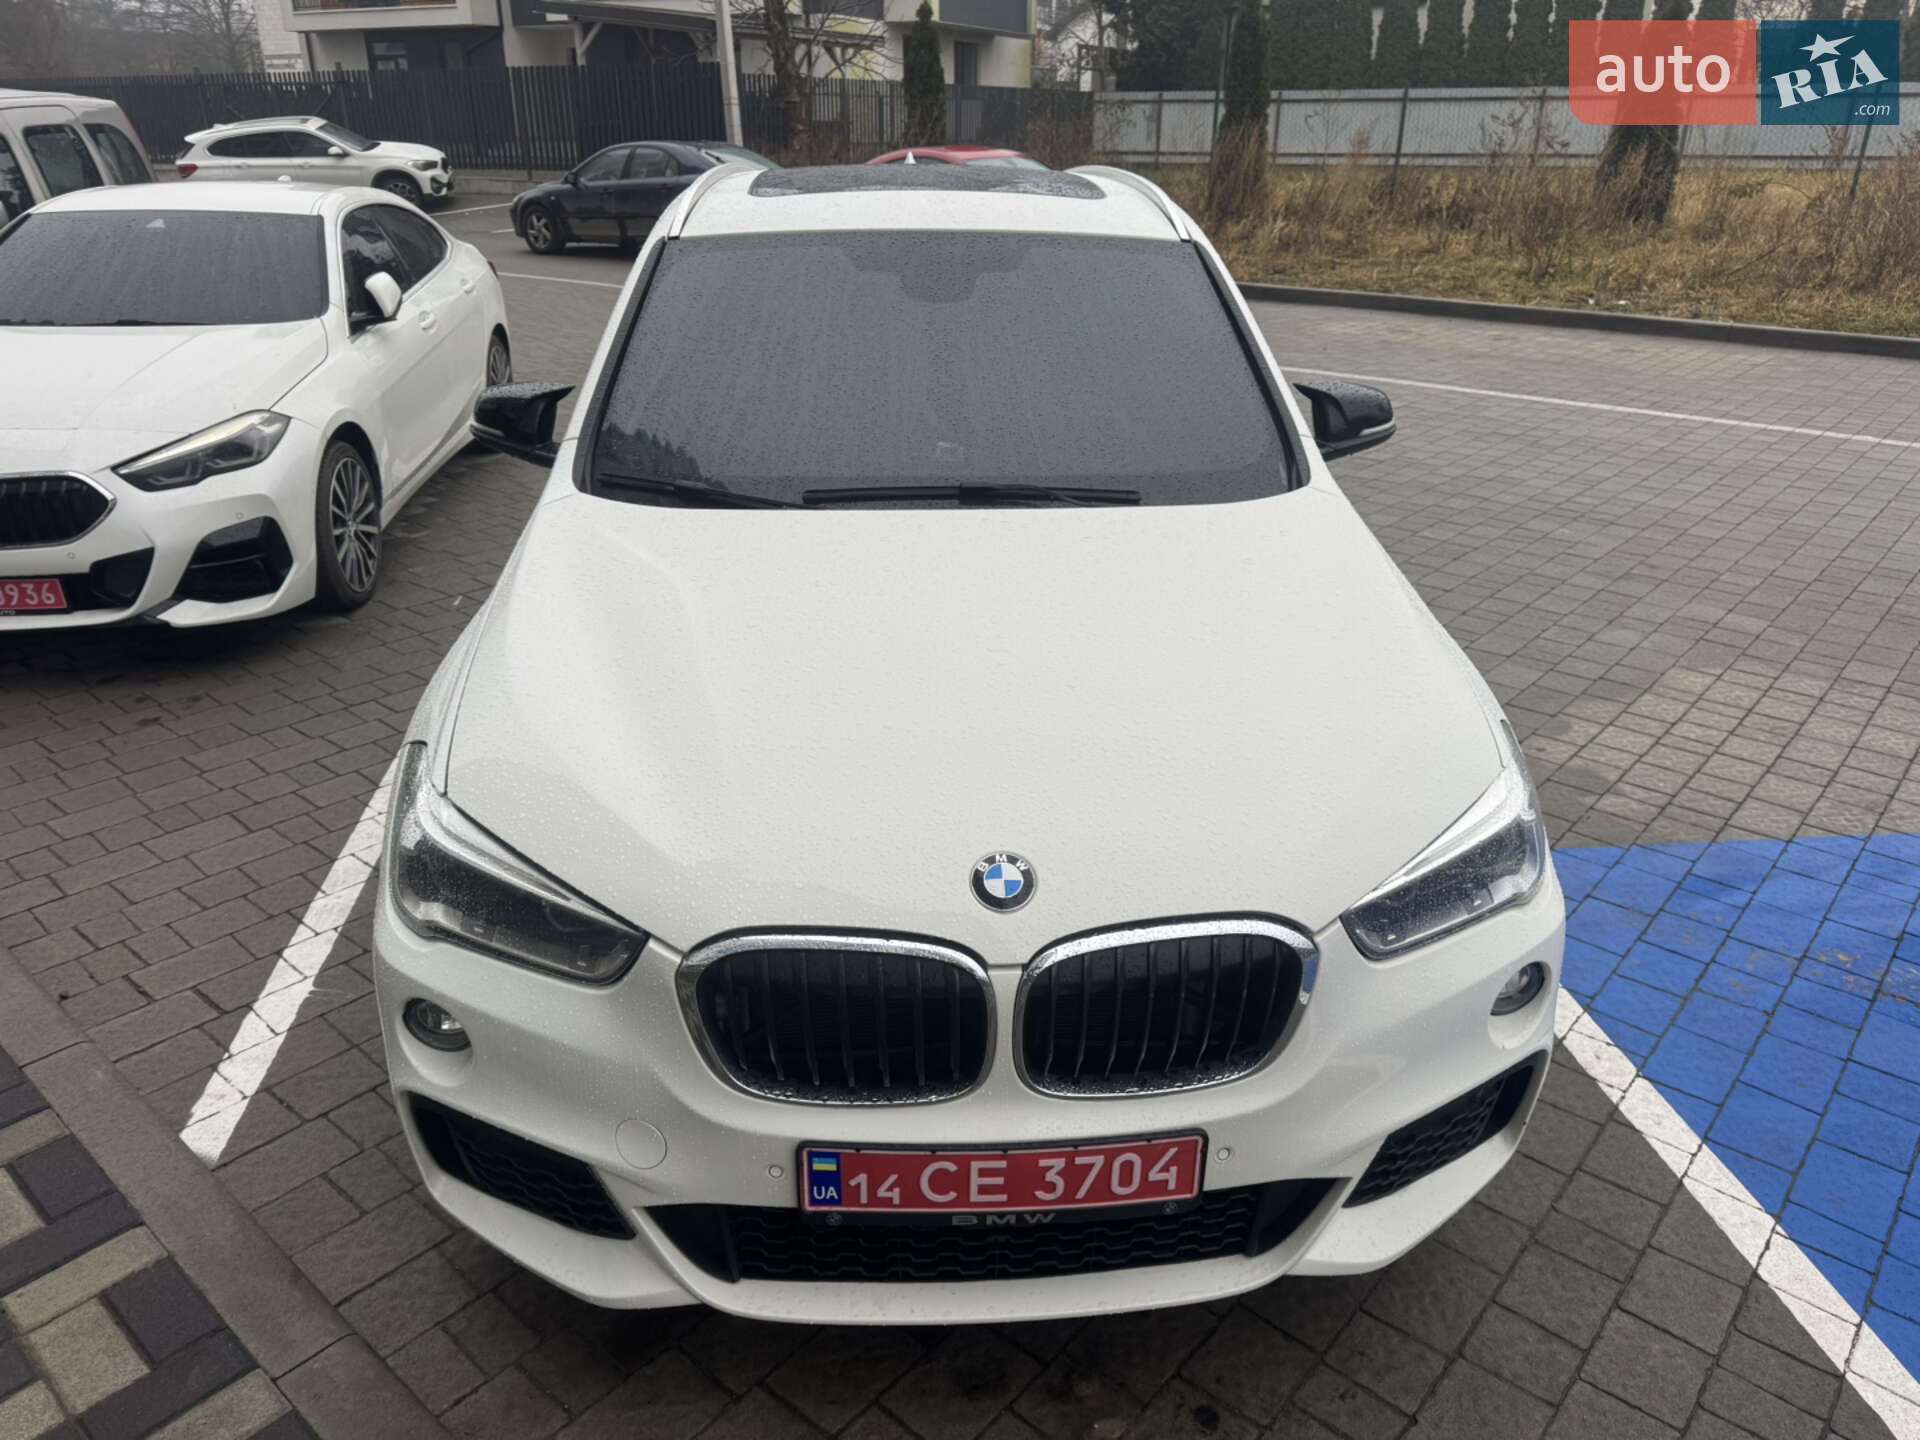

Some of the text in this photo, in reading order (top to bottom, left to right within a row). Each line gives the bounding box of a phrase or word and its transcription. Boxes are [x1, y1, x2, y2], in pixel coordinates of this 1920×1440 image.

[976, 853, 1029, 872] BMW
[848, 1147, 1178, 1205] 14 CE 3704
[813, 1185, 839, 1200] UA
[951, 1212, 1056, 1227] BMW
